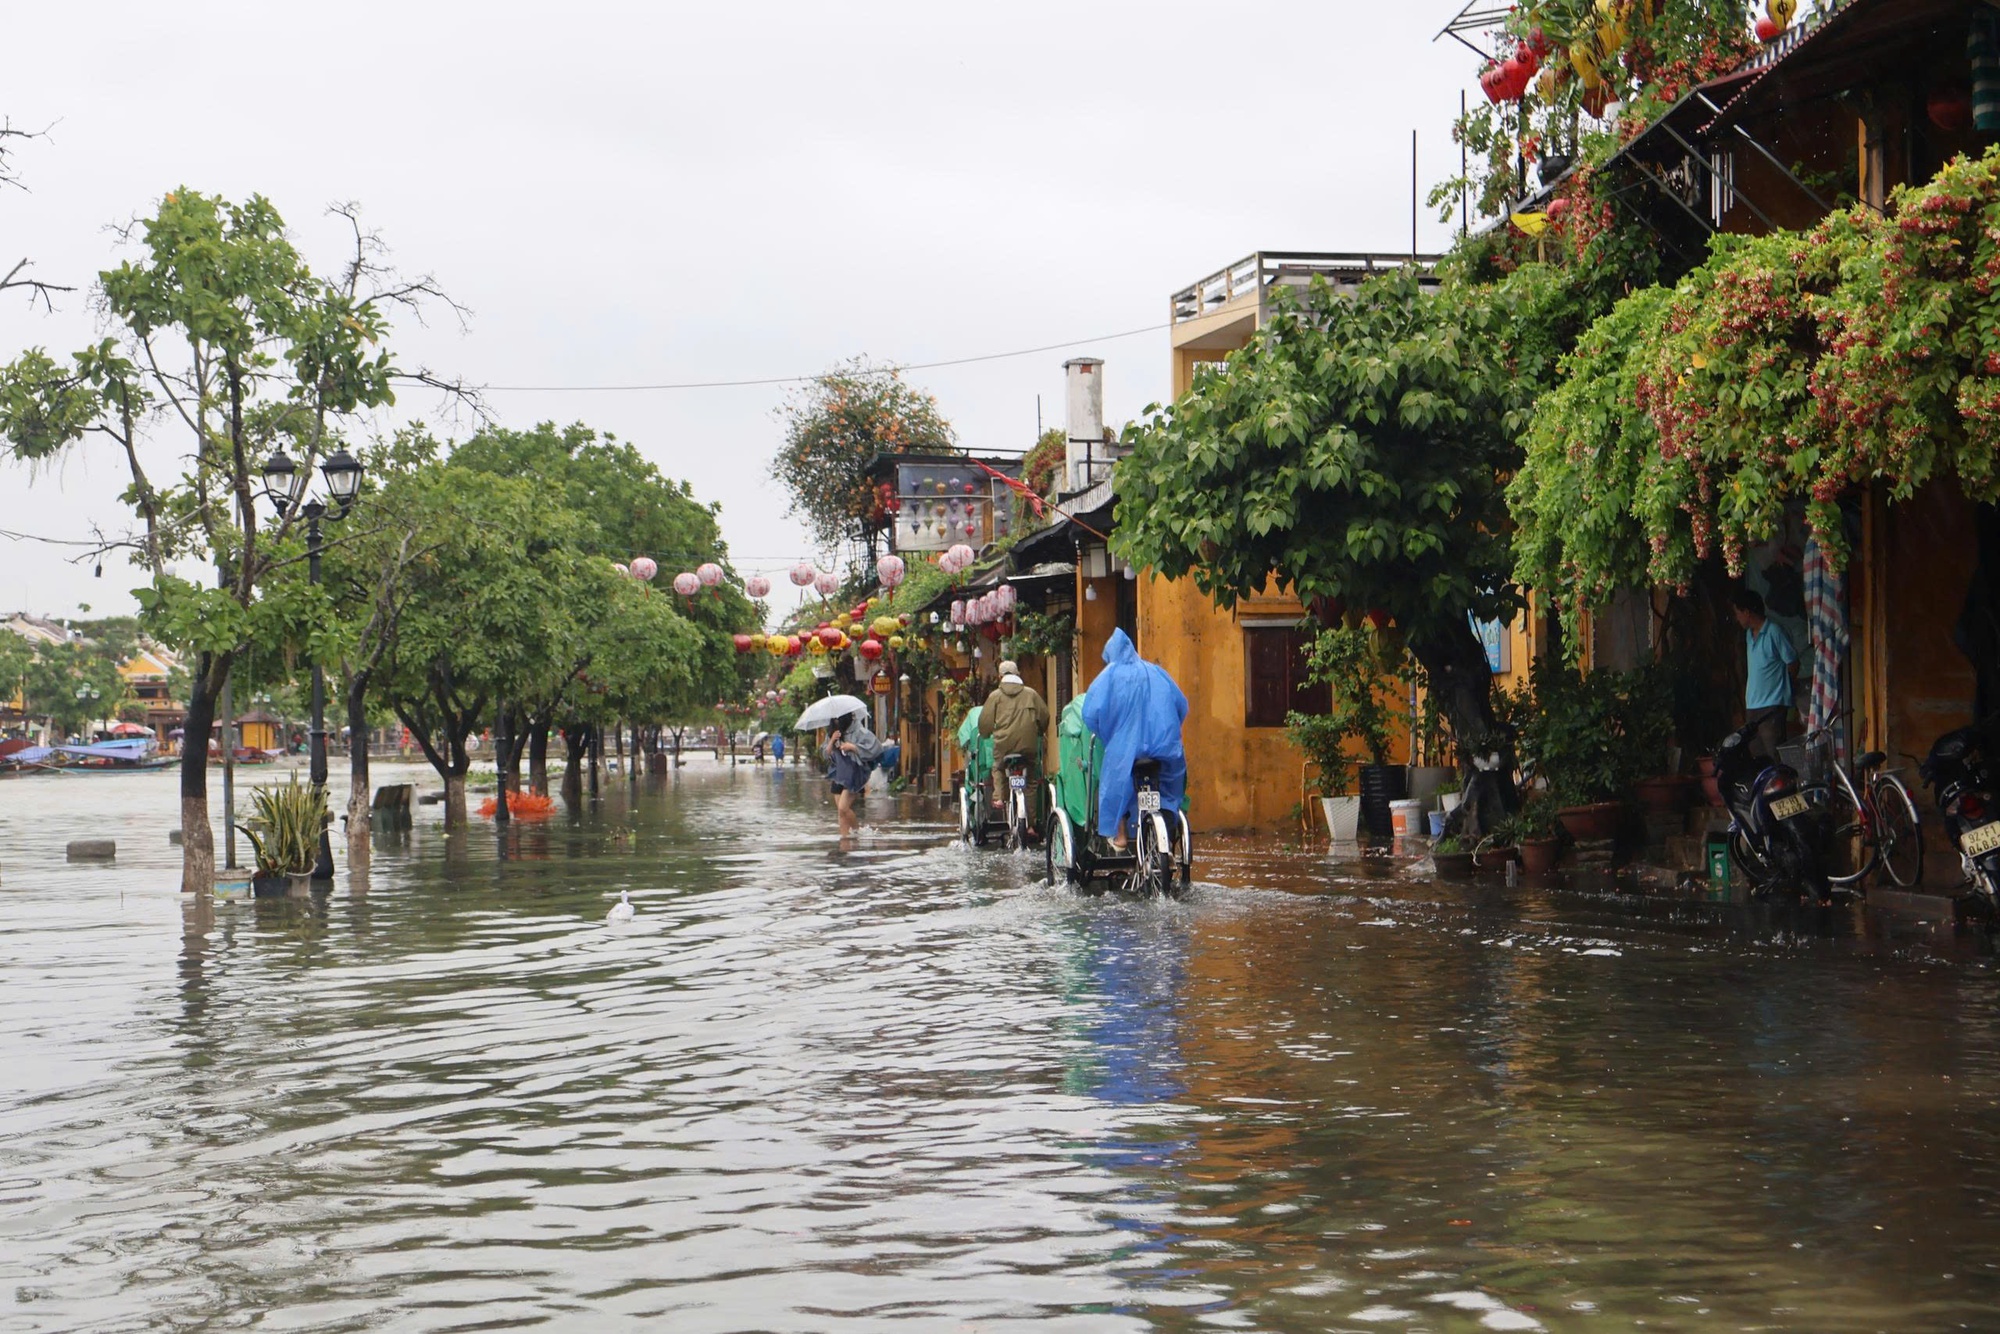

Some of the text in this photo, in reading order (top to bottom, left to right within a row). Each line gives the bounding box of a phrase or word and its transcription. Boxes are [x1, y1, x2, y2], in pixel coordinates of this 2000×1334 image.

[1011, 778, 1025, 787] 020
[1140, 794, 1158, 806] 032
[1968, 825, 1997, 844] 92-F1
[1969, 834, 2000, 855] 048.6
